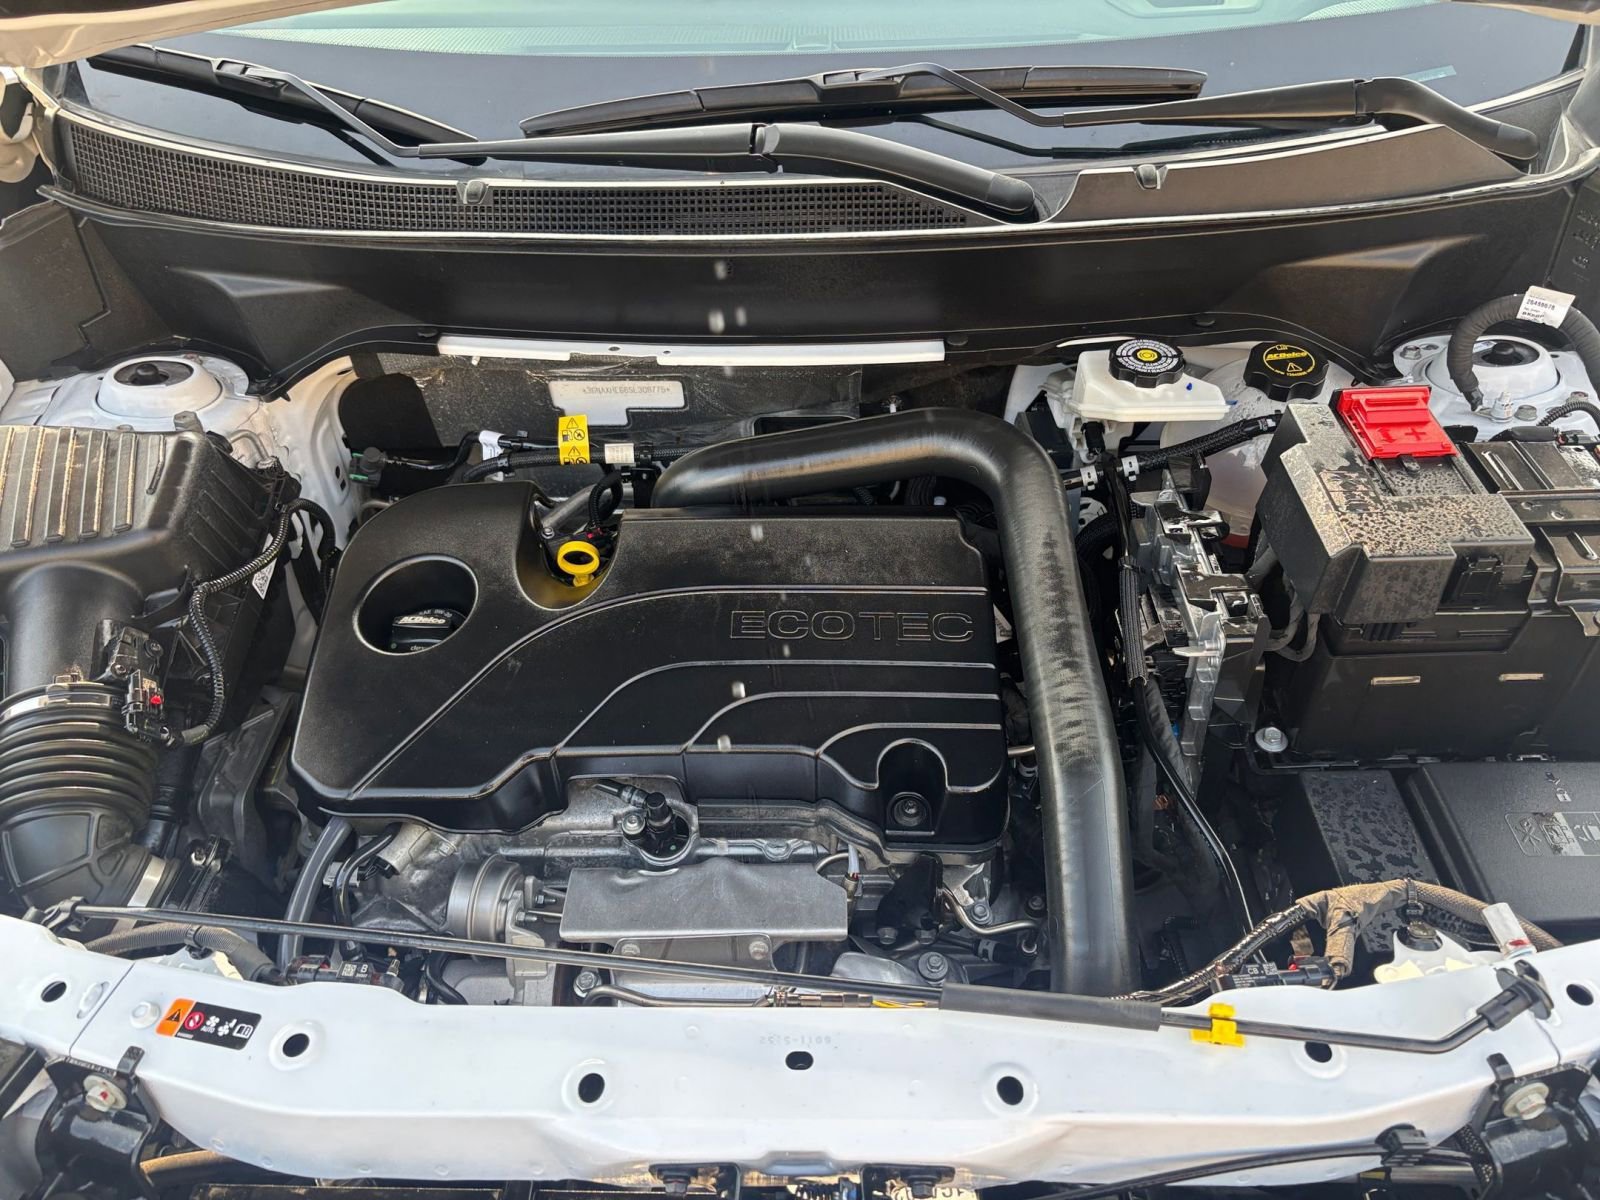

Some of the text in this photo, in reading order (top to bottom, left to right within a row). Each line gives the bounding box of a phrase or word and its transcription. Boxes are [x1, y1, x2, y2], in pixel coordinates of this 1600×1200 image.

[1265, 352, 1308, 361] ACDelco
[399, 615, 446, 625] ACDelco
[730, 609, 974, 642] ECOTEC
[360, 963, 369, 973] B
[200, 1025, 216, 1034] AUTO
